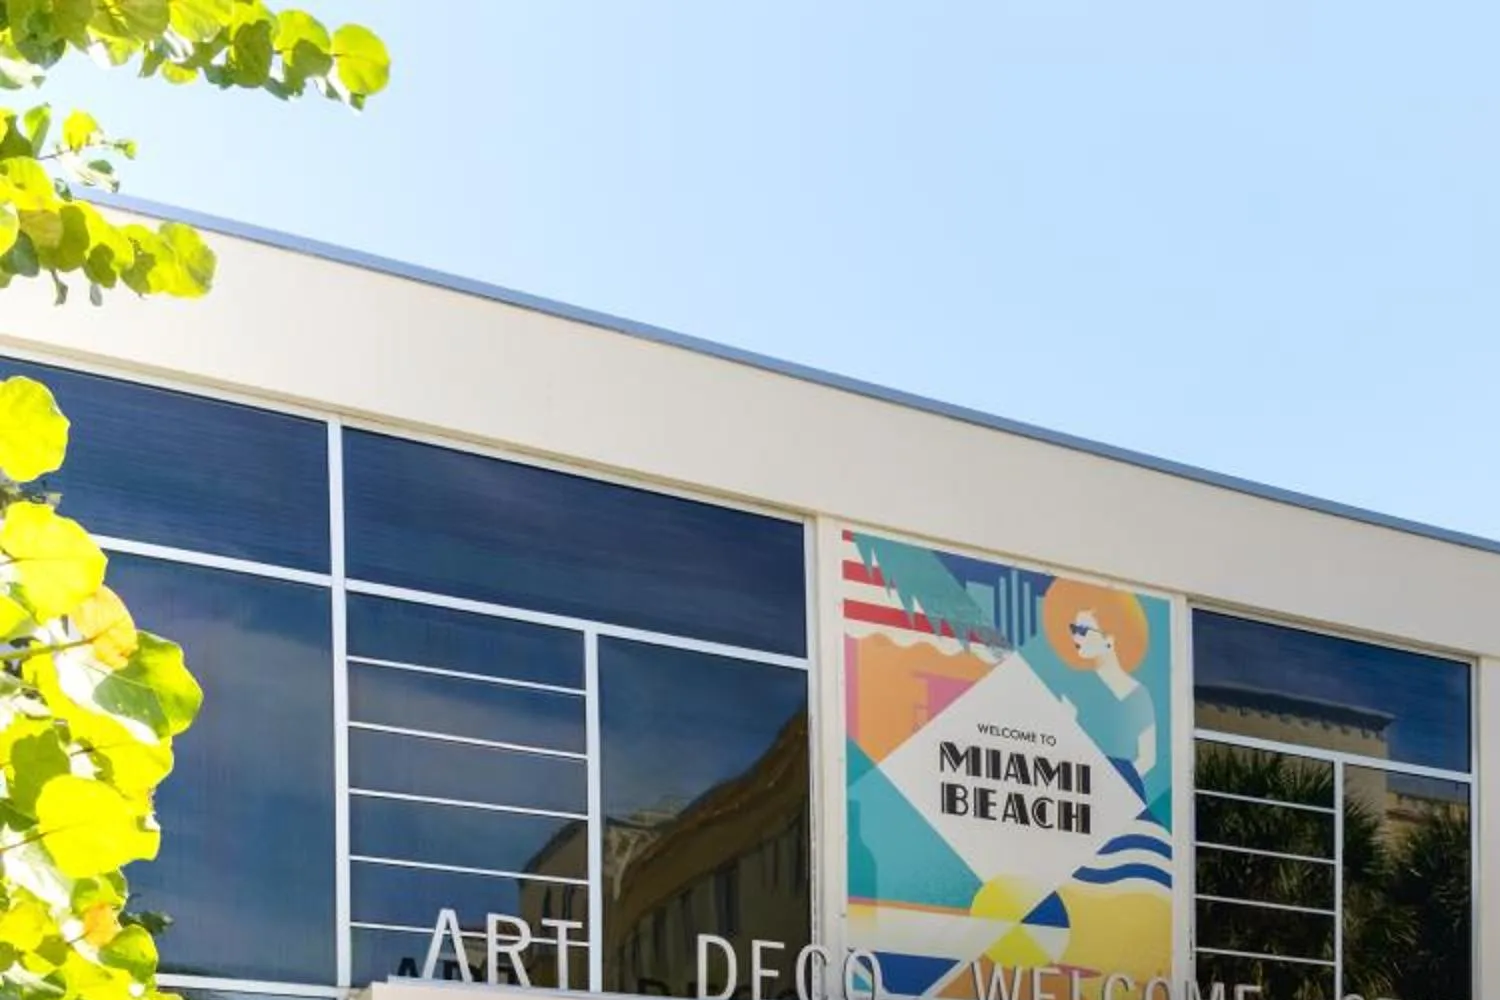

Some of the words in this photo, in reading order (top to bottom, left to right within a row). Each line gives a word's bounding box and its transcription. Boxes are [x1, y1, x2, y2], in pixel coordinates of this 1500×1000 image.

[977, 723, 1037, 743] WELCOME
[1040, 734, 1057, 747] TO
[939, 741, 1091, 794] MIAMI
[941, 782, 1091, 835] BEACH
[423, 908, 583, 991] ART
